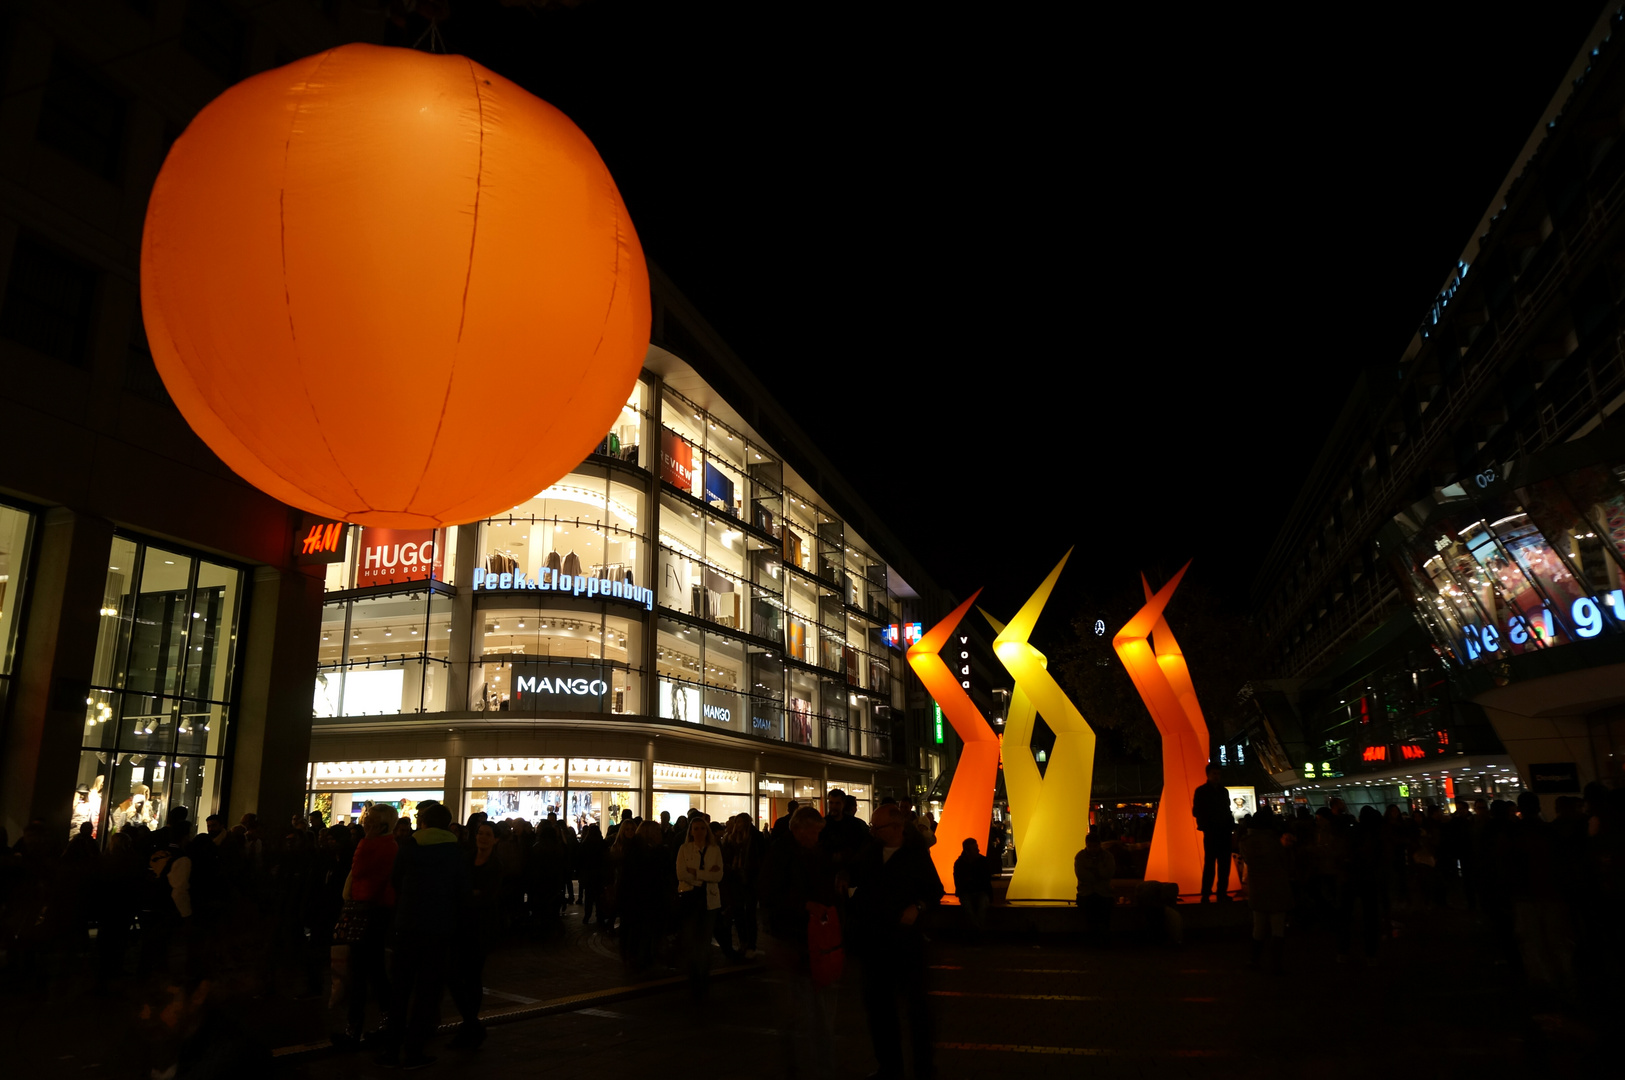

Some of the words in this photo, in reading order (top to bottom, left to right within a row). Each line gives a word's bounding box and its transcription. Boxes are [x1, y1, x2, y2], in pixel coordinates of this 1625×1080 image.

[302, 522, 343, 555] H&M
[364, 540, 439, 569] HUGO
[364, 567, 396, 577] HUGO
[516, 675, 608, 696] MANGO
[703, 703, 731, 722] MANGO
